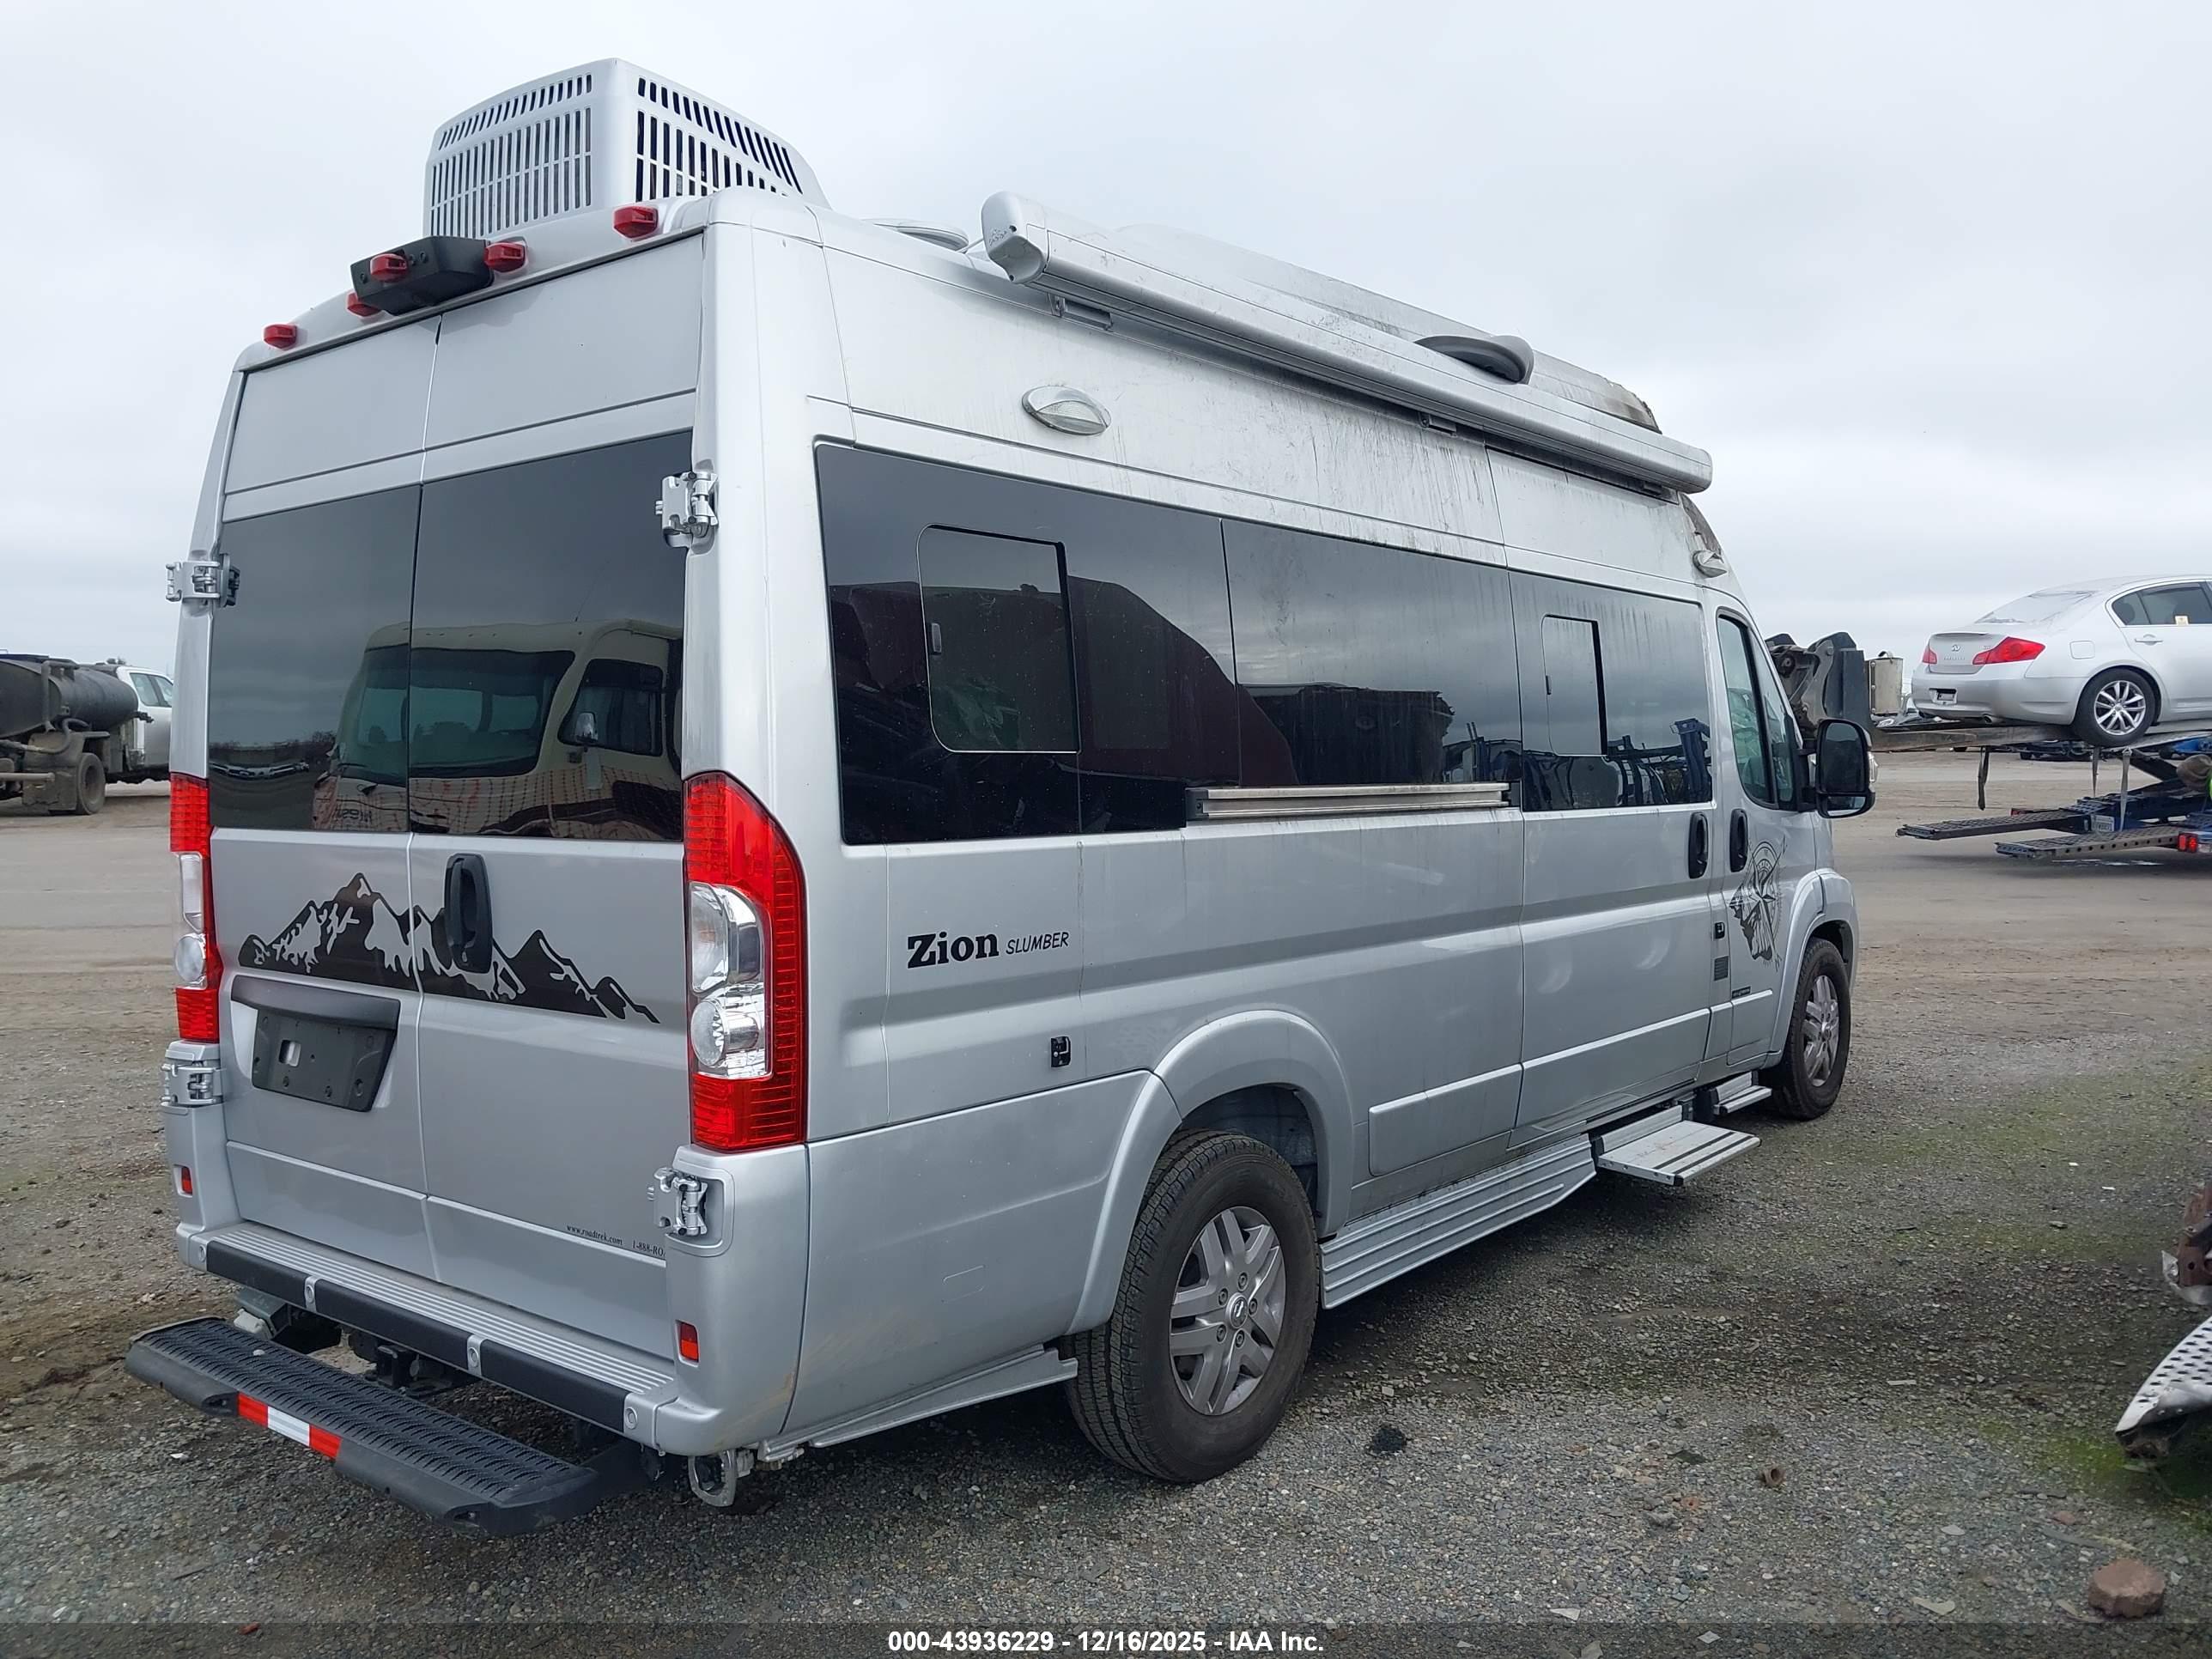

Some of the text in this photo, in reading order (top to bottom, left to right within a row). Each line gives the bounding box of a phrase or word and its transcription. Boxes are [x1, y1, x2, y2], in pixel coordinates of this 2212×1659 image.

[907, 931, 1070, 969] Zion SLUMBER
[566, 1224, 666, 1257] www.roadtrek.com 1-888-RO
